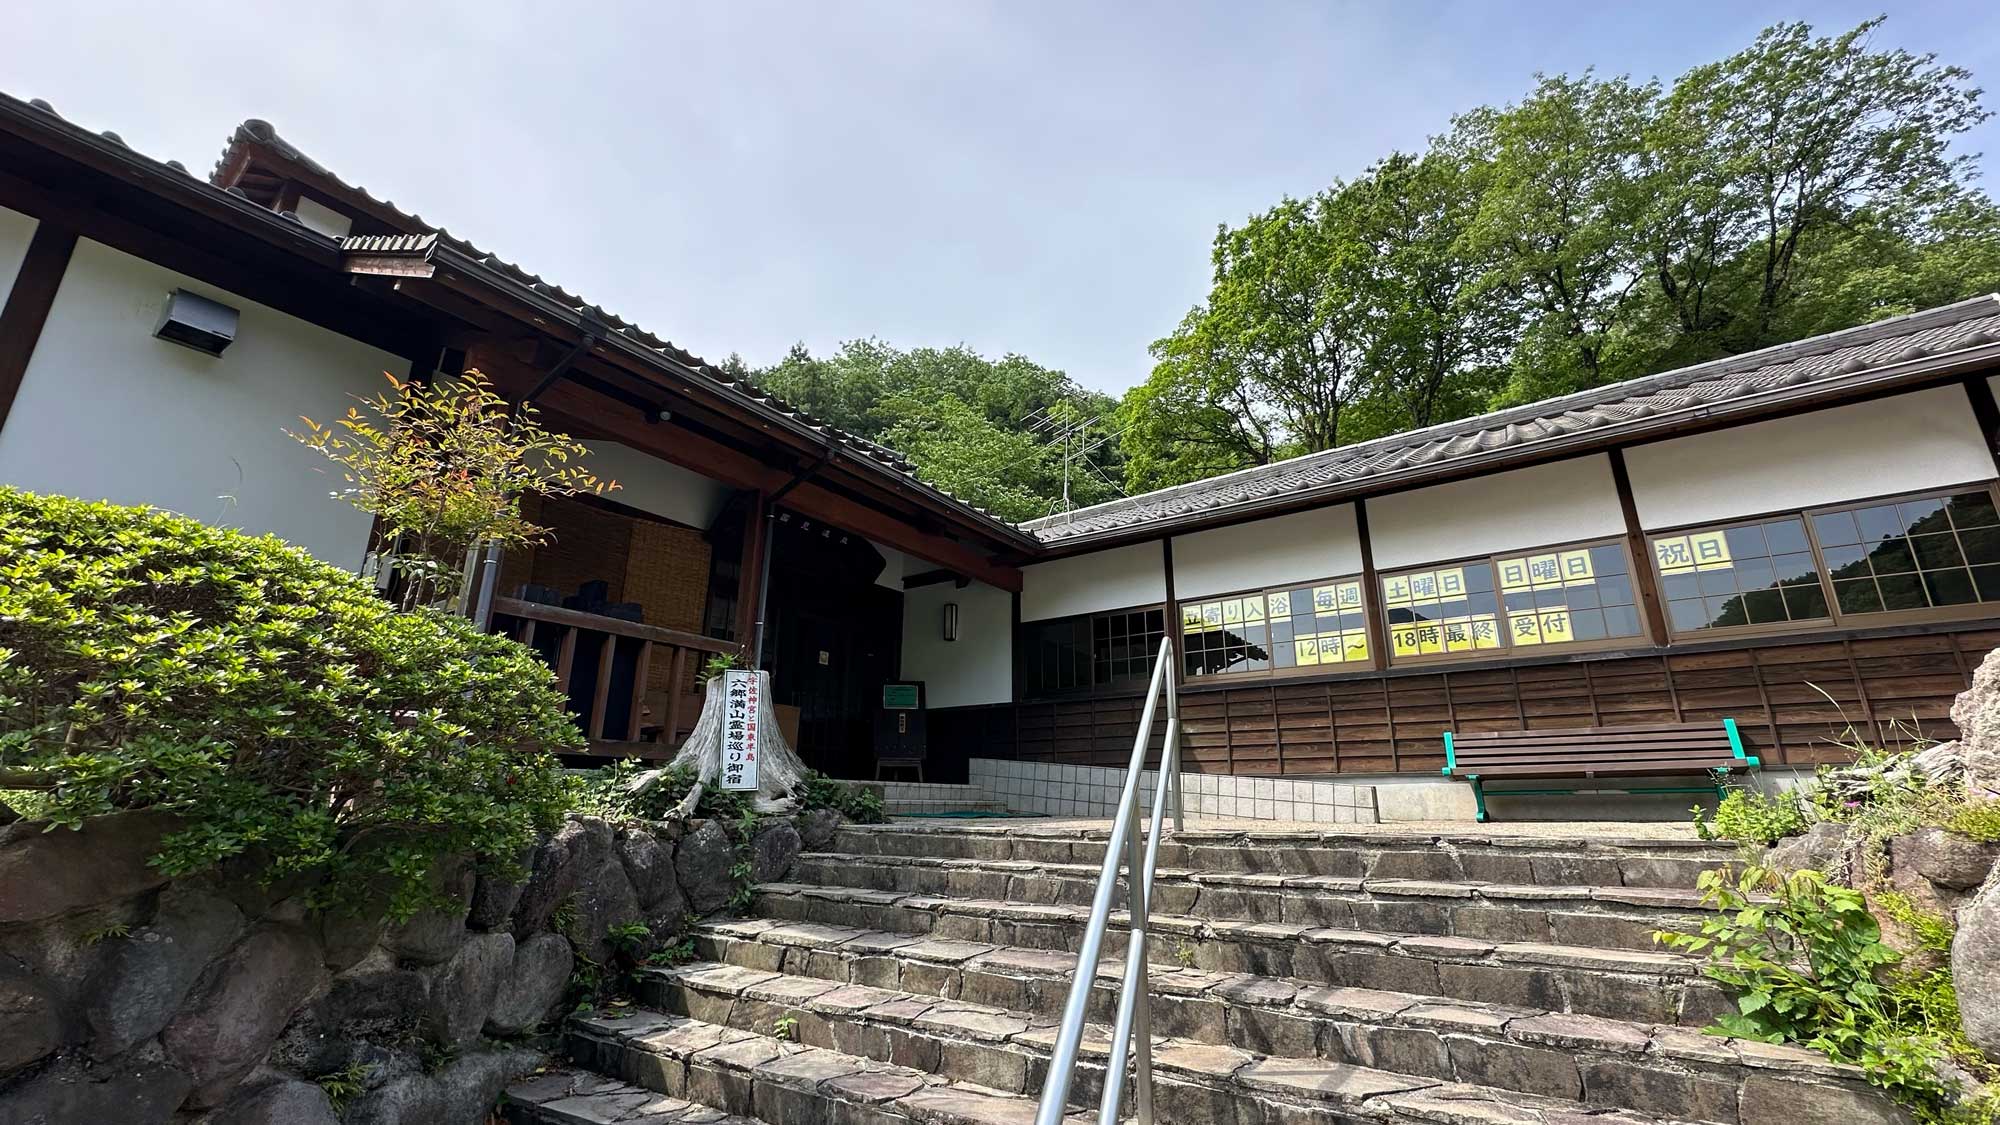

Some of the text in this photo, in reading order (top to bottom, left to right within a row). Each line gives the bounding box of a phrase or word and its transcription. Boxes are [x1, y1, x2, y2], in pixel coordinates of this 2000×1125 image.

[1185, 539, 1723, 626] 立寄り入浴 毎週 土曜日 日曜日 祝日
[726, 678, 748, 785] 六郷満山霊場巡り御宿
[745, 676, 758, 762] 宇佐神宮と国東半島
